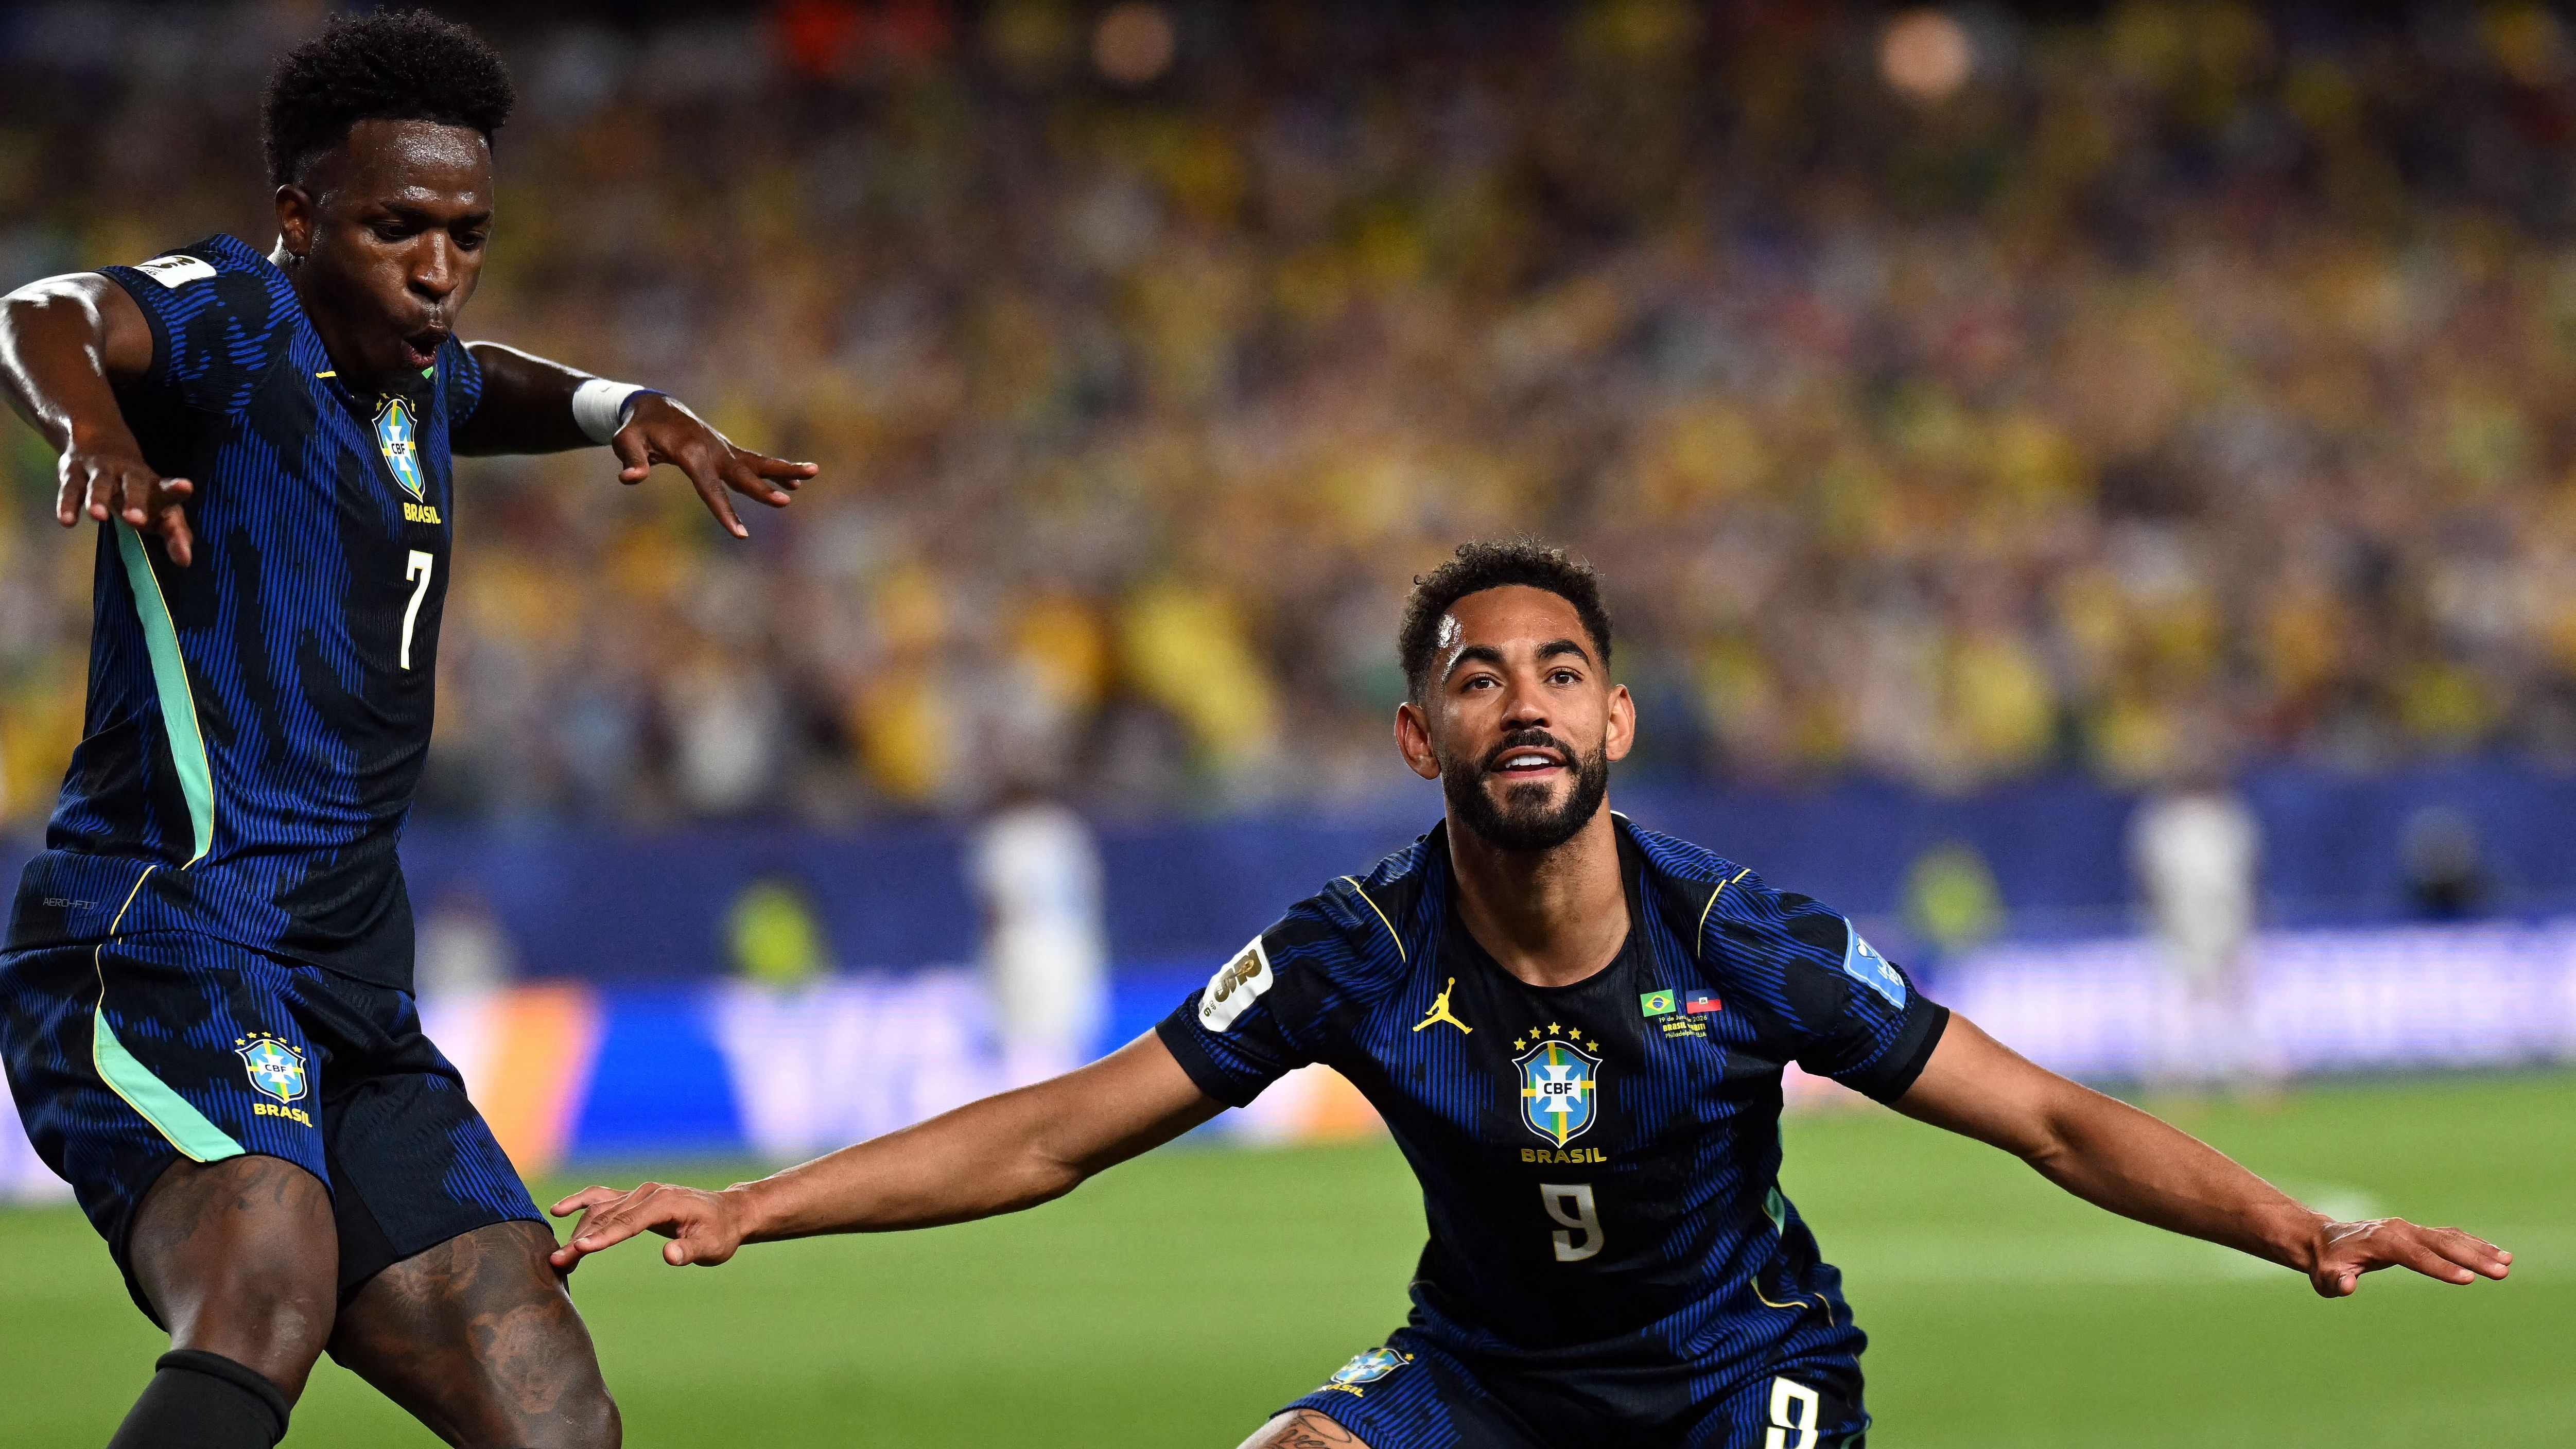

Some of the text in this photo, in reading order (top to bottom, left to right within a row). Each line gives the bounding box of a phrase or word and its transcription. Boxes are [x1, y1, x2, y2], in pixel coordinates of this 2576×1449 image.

[392, 443, 406, 455] CBF
[403, 502, 441, 524] BRASIL
[401, 549, 433, 670] 7
[43, 897, 99, 910] AERO-FIT
[1204, 1007, 1212, 1017] 6
[1665, 1029, 1695, 1039] Philadelph
[265, 1064, 287, 1073] CBF
[1543, 1083, 1573, 1095] CBF
[253, 1103, 313, 1128] BRASIL
[1521, 1147, 1607, 1163] BRASIL
[1539, 1183, 1605, 1262] 9
[1318, 1383, 1364, 1398] ASIL
[1764, 1375, 1819, 1449] 9
